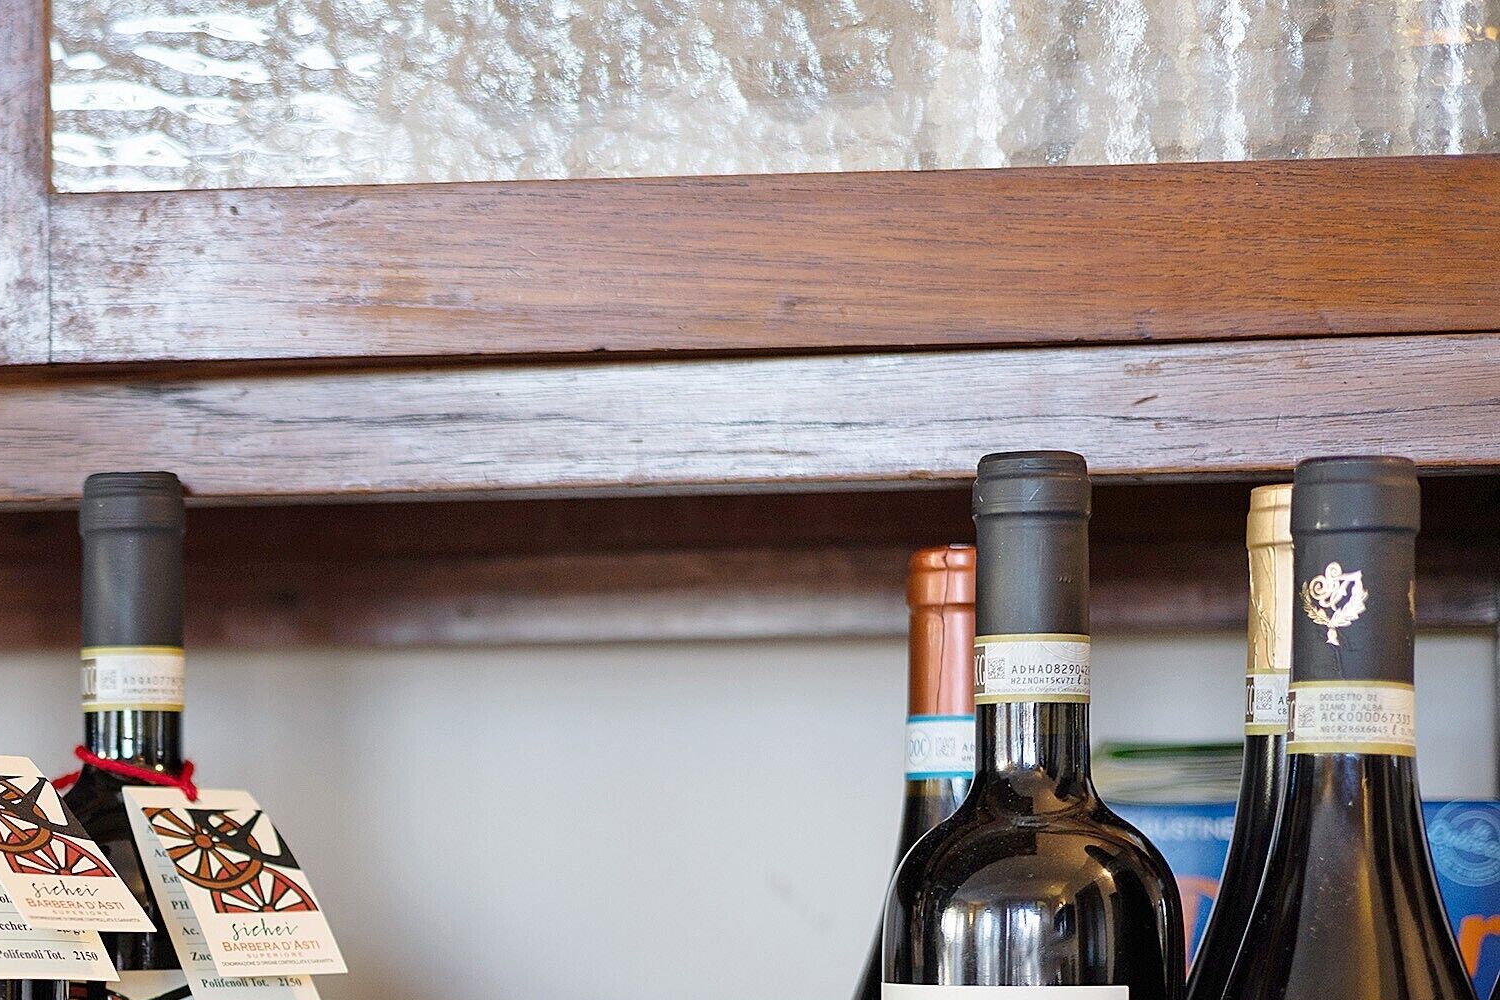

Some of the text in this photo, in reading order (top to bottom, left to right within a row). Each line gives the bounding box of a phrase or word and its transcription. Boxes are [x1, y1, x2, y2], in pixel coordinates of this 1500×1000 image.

[1320, 693, 1377, 702] DOLCETTO DI
[25, 897, 84, 910] BARBERA
[171, 901, 190, 910] PH
[182, 926, 199, 936] Ac.
[222, 941, 280, 952] BARBERA
[46, 950, 65, 960] Tot.
[73, 950, 99, 961] 2150
[202, 978, 302, 988] Polifenoli Tot. 2150
